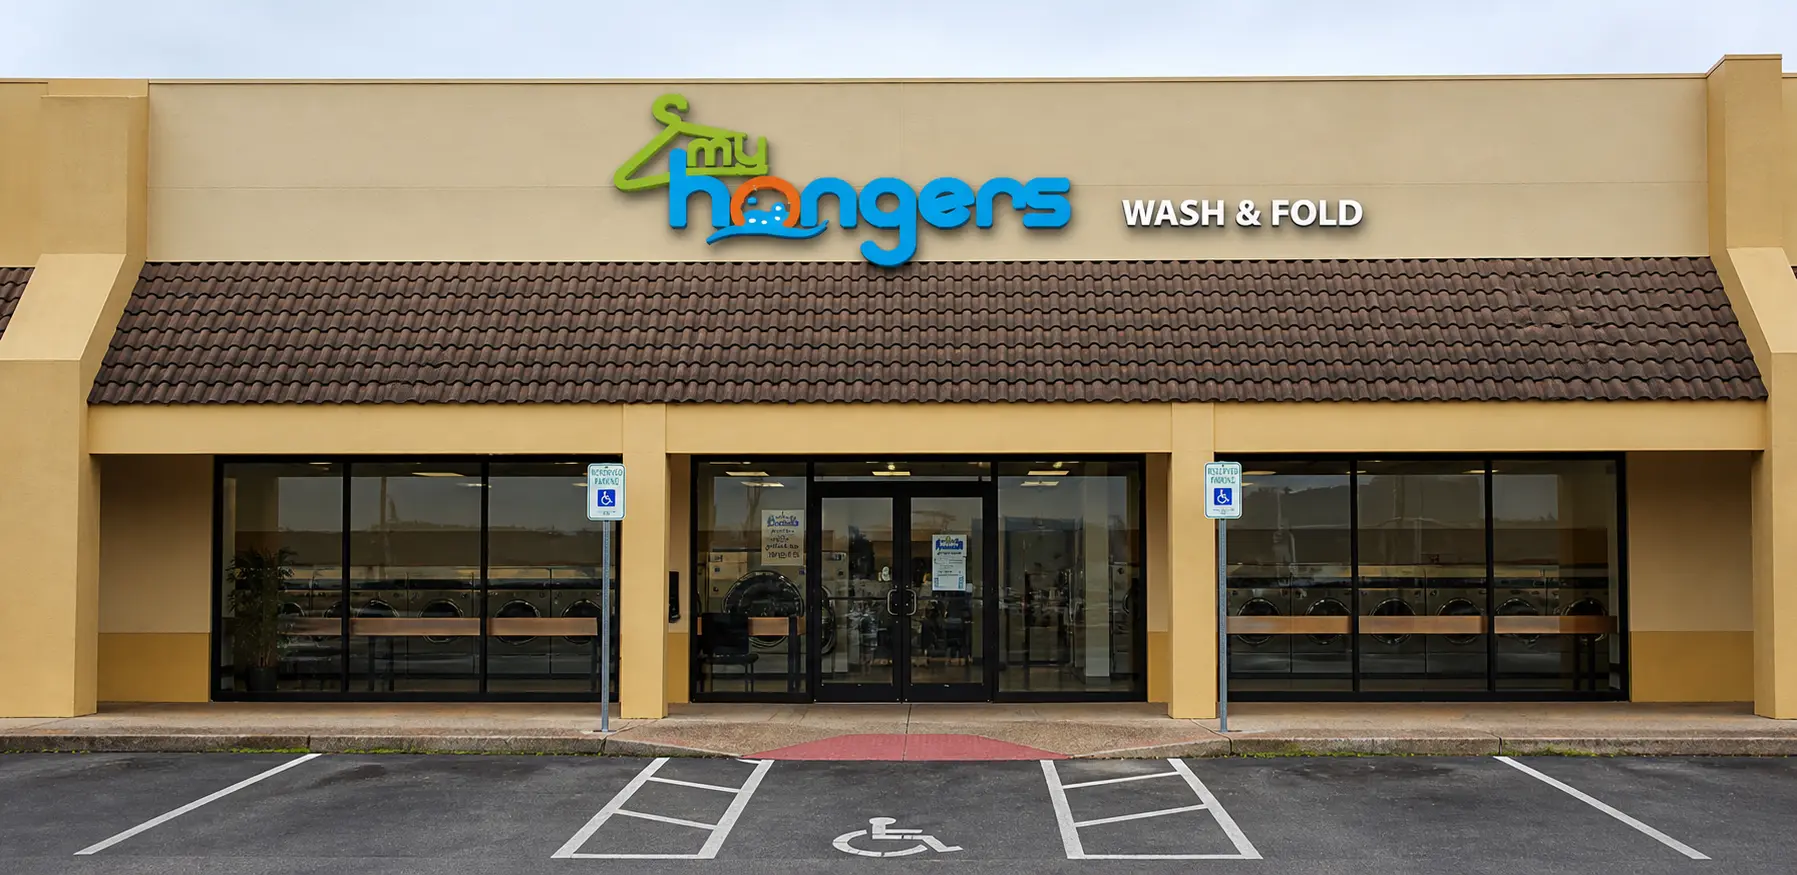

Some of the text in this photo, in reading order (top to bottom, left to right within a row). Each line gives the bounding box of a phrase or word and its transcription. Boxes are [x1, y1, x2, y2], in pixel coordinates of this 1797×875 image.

[687, 134, 768, 176] my
[1121, 199, 1364, 227] WASH & FOLD
